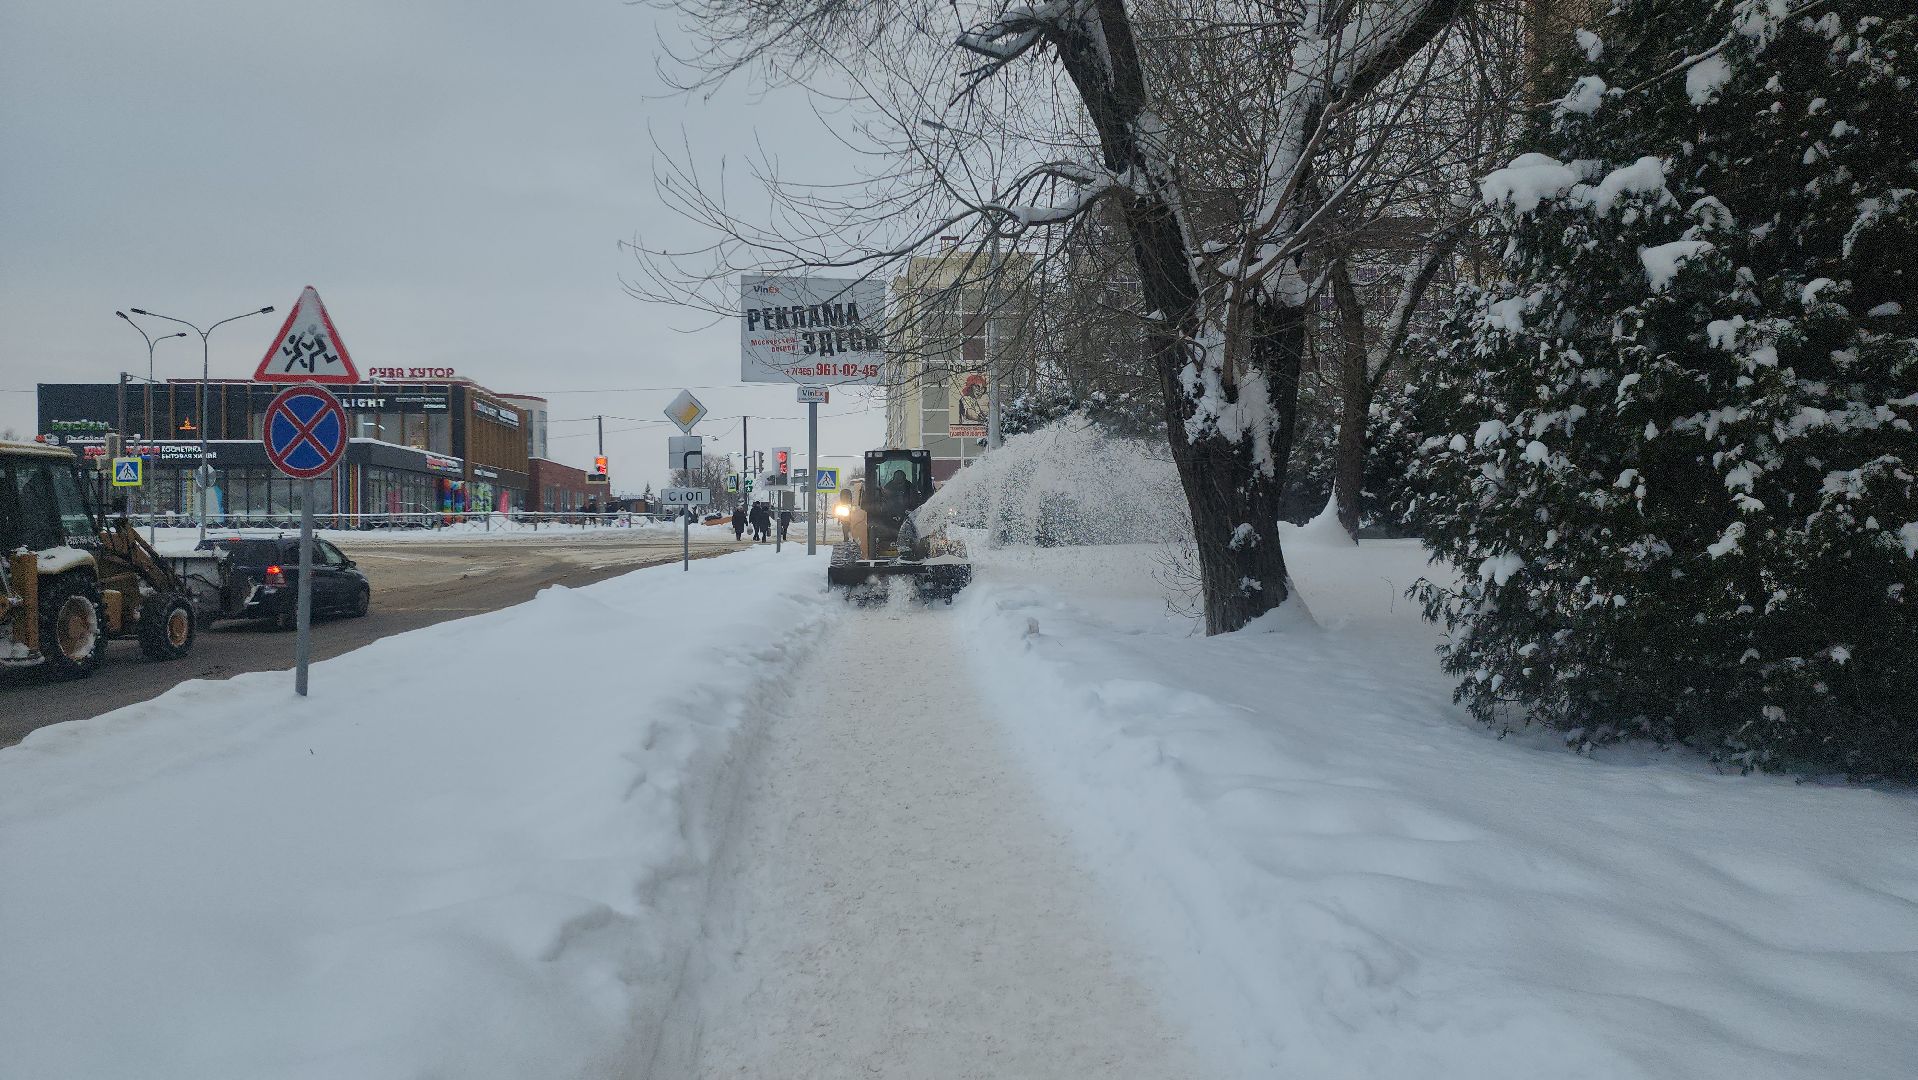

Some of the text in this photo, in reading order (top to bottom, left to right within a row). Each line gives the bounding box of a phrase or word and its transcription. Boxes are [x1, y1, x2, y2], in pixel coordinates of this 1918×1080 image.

[753, 285, 779, 294] VinEx
[747, 303, 860, 331] РЕКЛАМА
[802, 327, 878, 357] ЗДЕСЬ
[369, 367, 455, 378] РУЗА ХУТОР
[802, 389, 824, 397] VinEx
